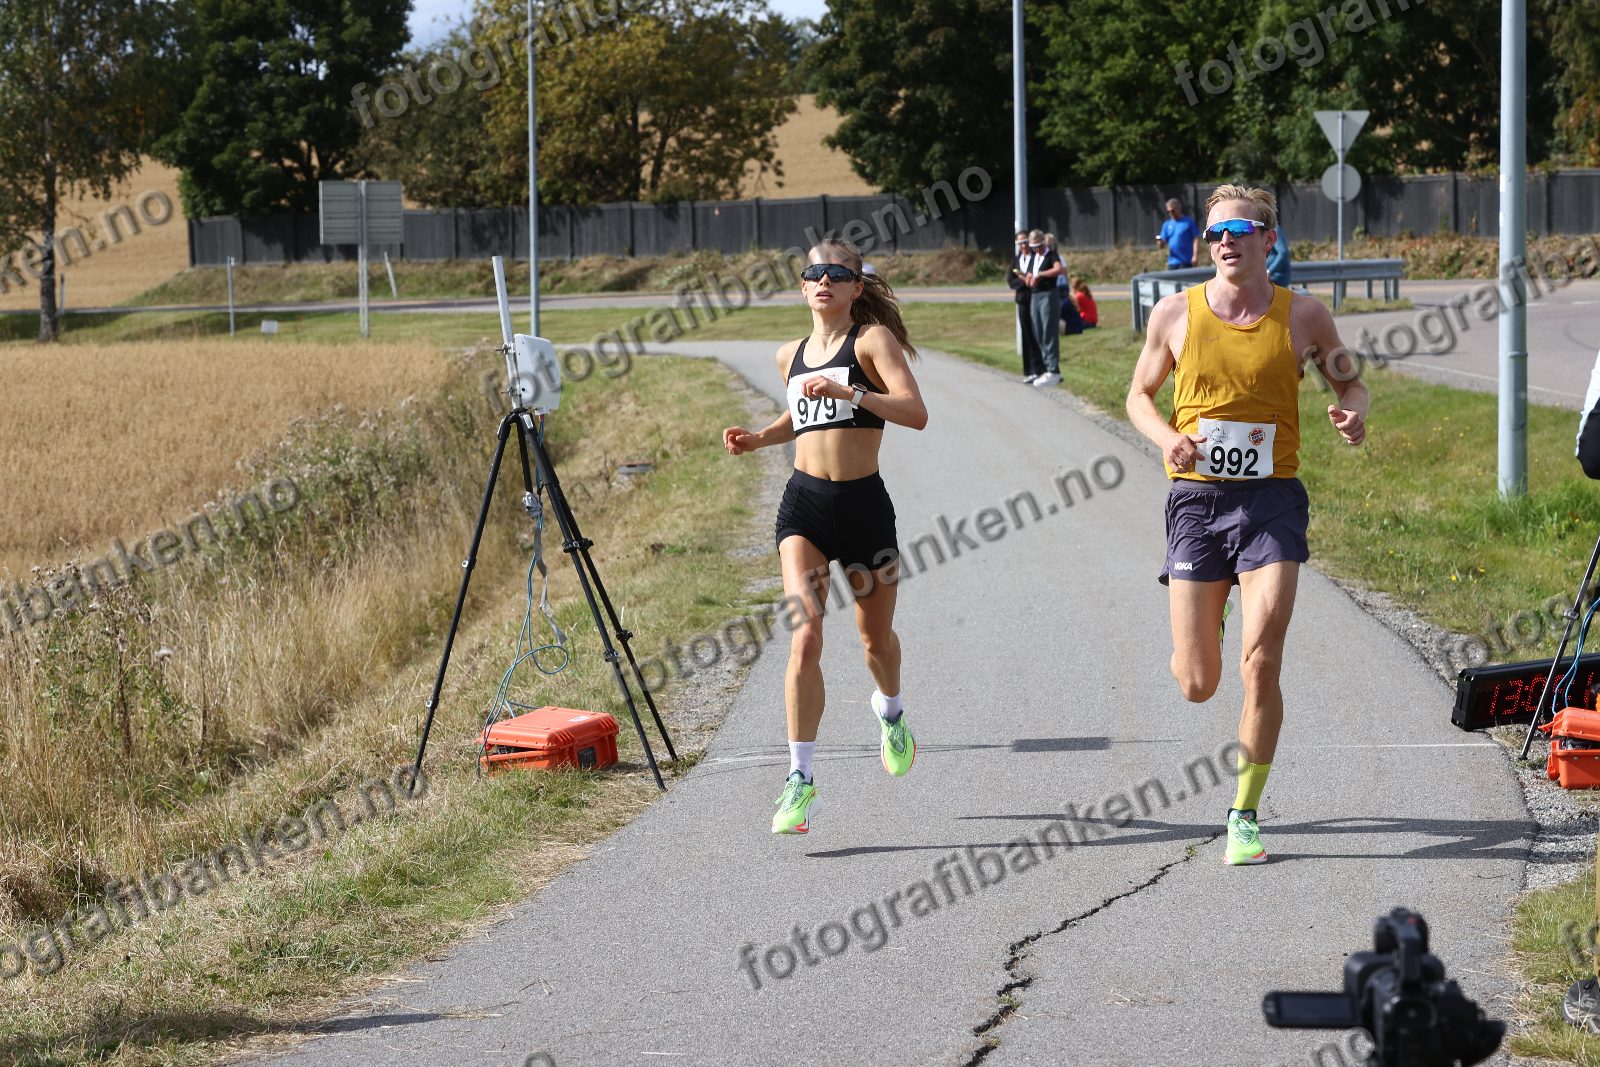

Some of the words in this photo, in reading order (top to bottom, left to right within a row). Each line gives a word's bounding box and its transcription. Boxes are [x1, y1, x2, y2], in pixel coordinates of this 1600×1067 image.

[797, 395, 837, 425] 979
[1209, 445, 1259, 477] 992
[1174, 561, 1193, 571] HOKA
